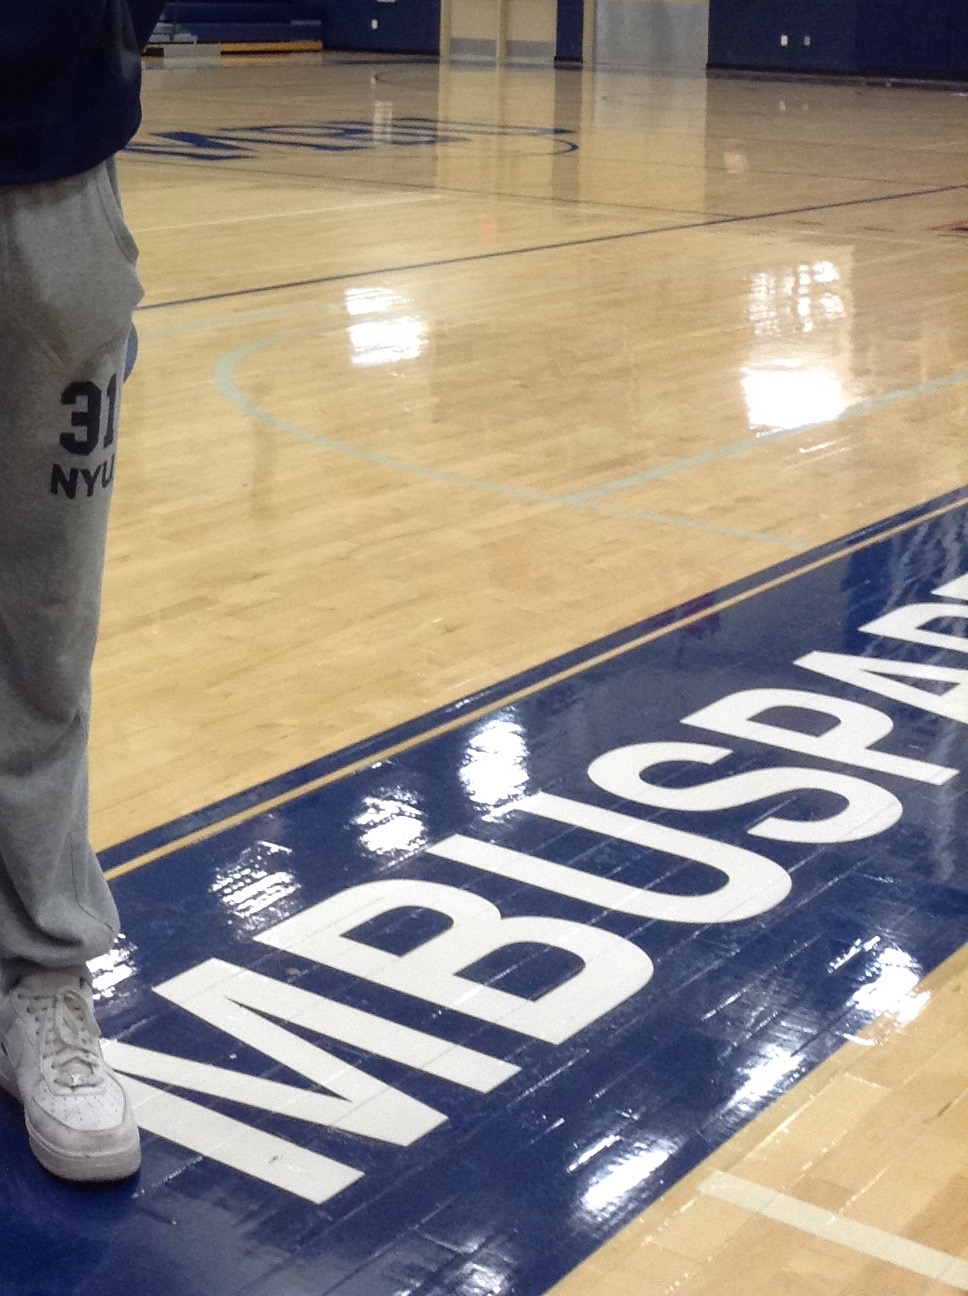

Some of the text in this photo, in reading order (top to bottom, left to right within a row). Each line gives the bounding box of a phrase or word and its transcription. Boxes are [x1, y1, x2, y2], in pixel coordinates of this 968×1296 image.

[59, 373, 118, 456] 31
[50, 454, 116, 500] NYU
[100, 572, 968, 1204] MBUSPA
